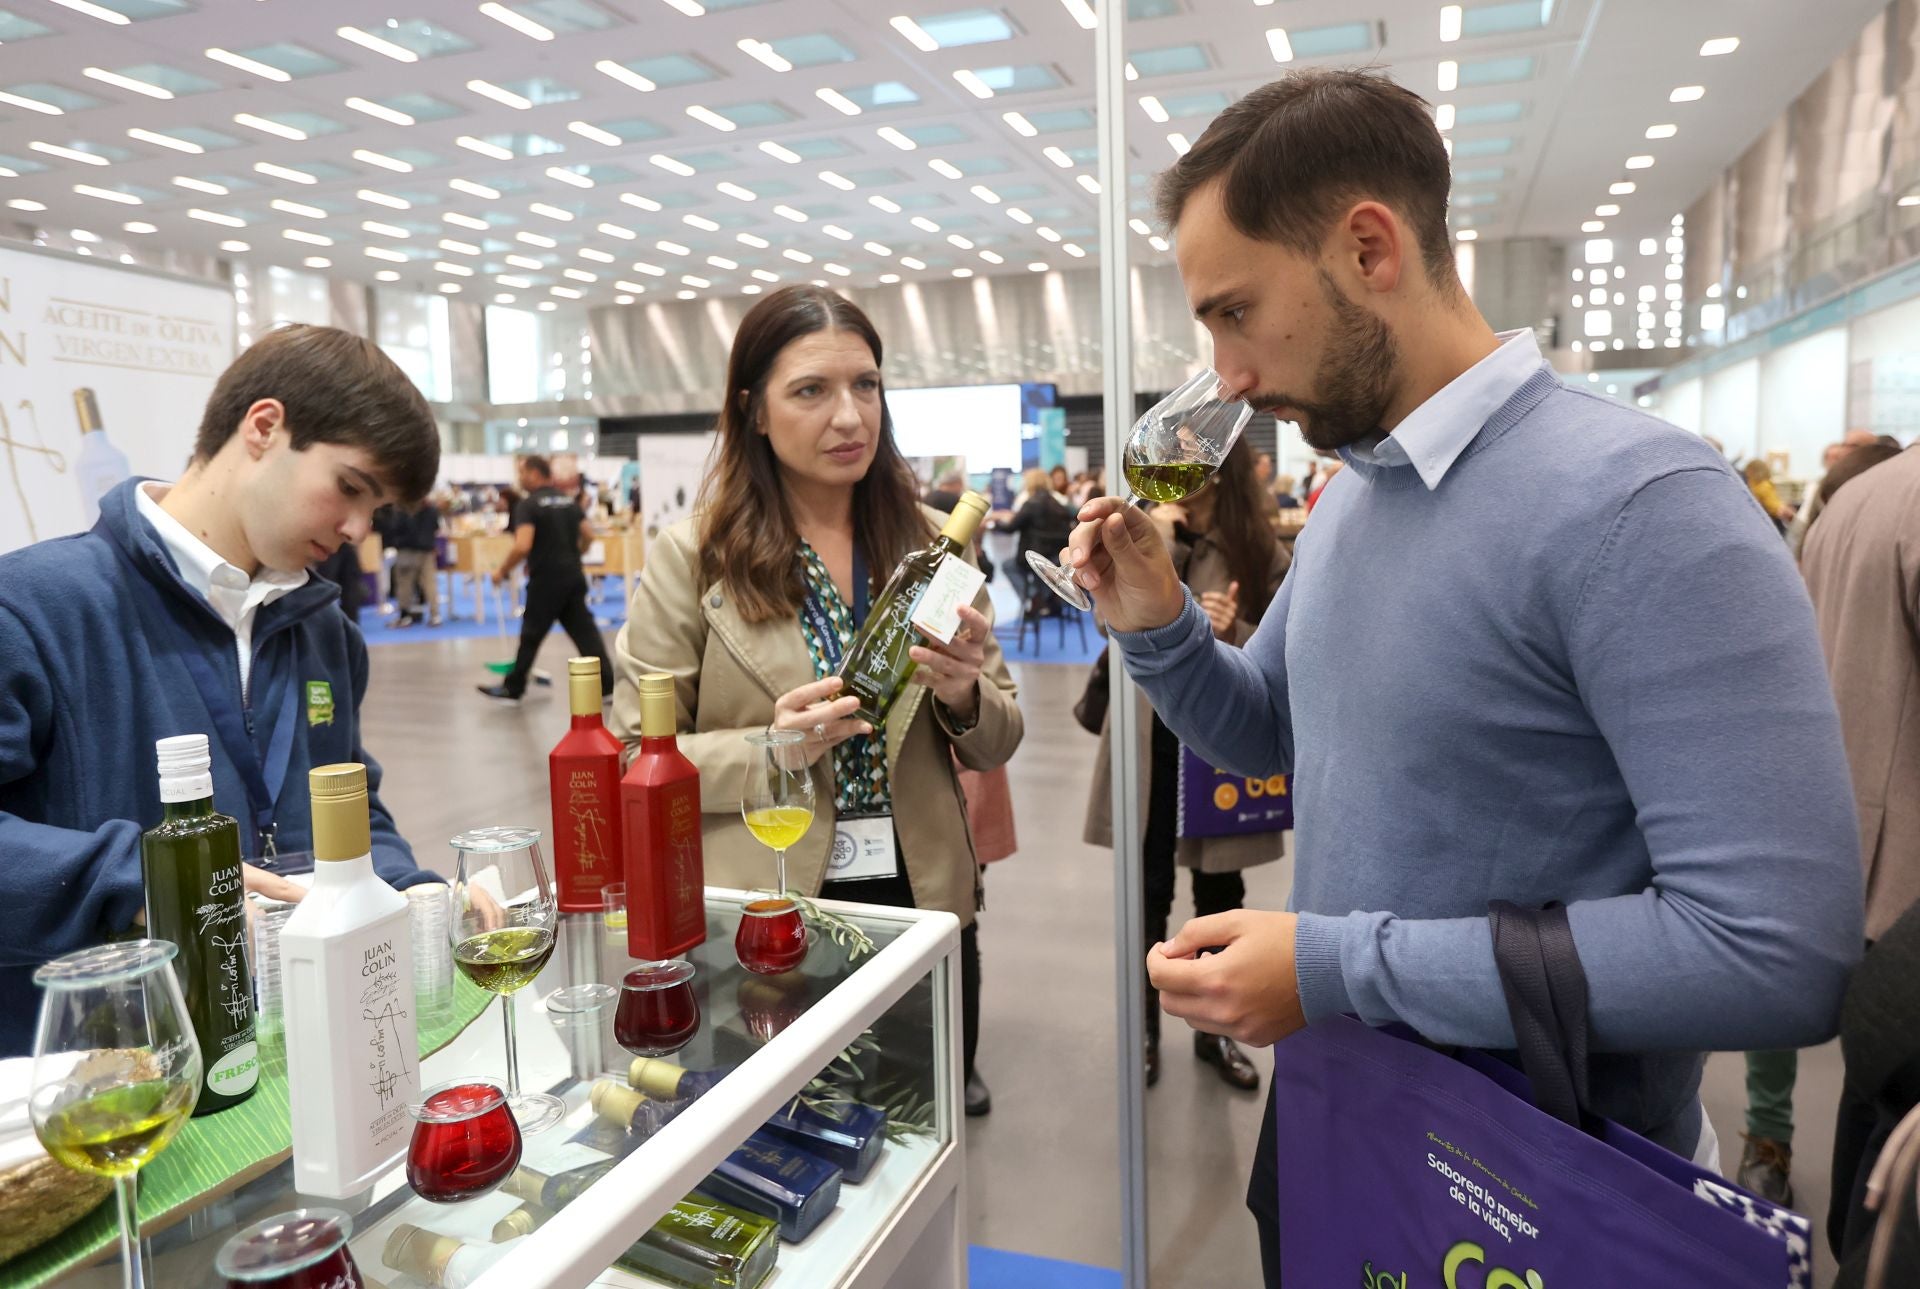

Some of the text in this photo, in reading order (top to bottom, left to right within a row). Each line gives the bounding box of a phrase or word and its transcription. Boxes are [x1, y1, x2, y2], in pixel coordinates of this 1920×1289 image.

[44, 304, 126, 336] ACEITE
[158, 320, 222, 346] OLIVA
[55, 333, 213, 370] VIRGEN EXTRA
[569, 779, 597, 789] COLIN
[571, 771, 594, 781] JUAN
[211, 864, 239, 885] JUAN
[208, 877, 242, 897] COLIN
[364, 939, 392, 965] JUAN
[361, 953, 396, 977] COLIN
[1455, 1147, 1464, 1157] de
[1427, 1152, 1539, 1239] Saborea lo mejor
[1449, 1185, 1512, 1244] de la vida,
